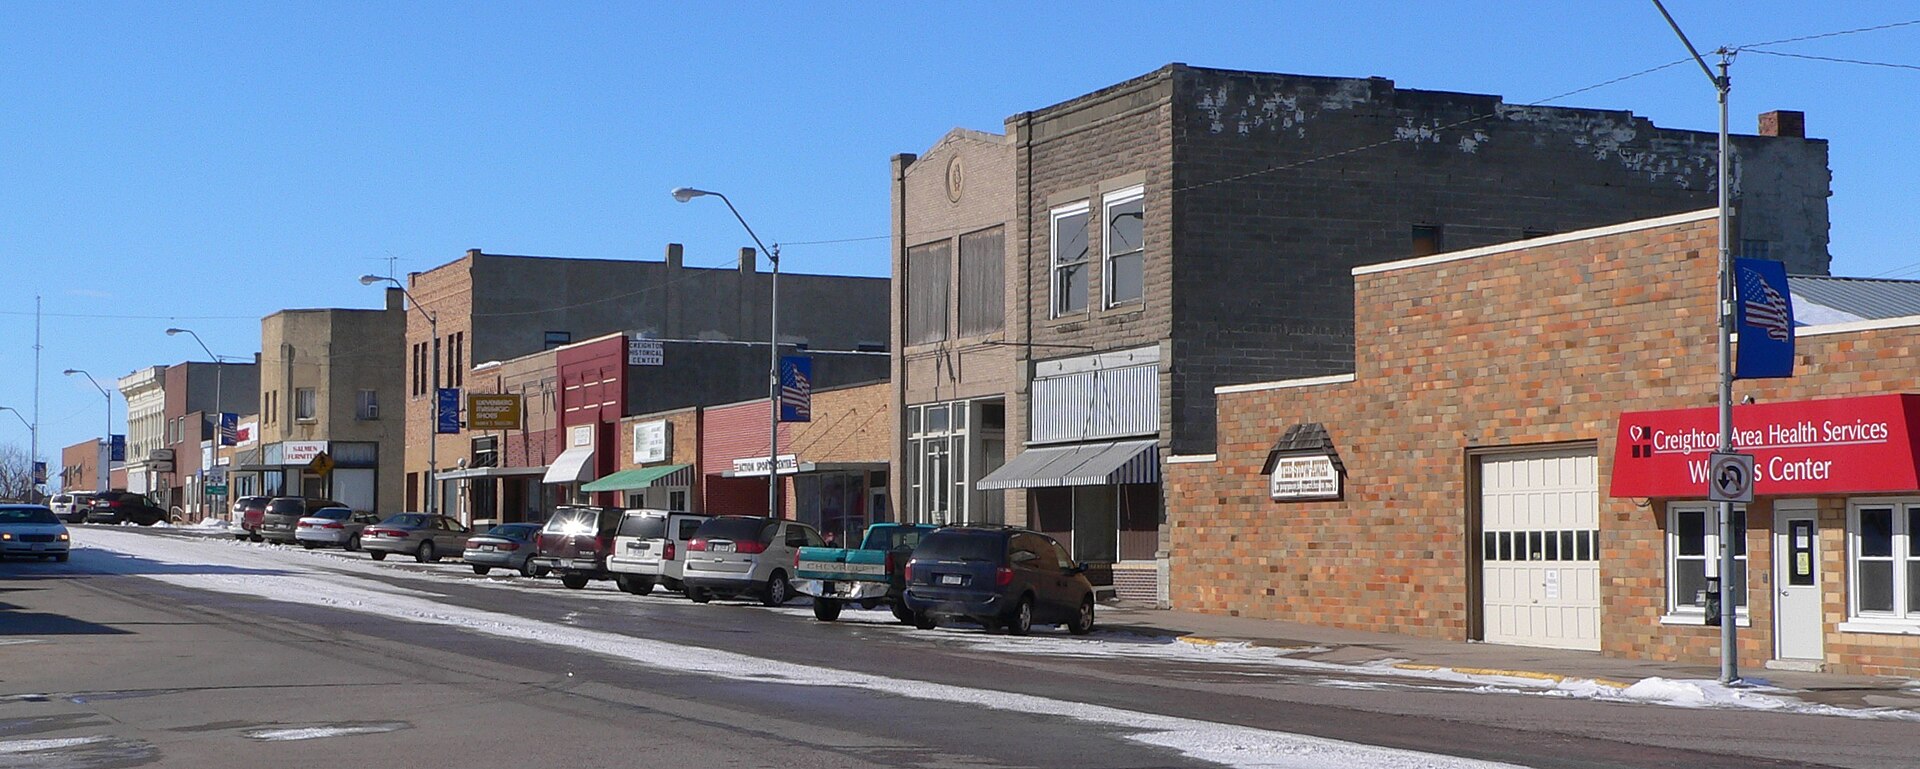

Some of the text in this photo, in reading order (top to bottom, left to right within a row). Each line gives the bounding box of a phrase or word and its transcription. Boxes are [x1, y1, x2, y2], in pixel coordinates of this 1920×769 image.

[1731, 427, 1763, 446] Area
[1768, 421, 1817, 444] Health
[1823, 418, 1888, 442] Services
[1769, 456, 1832, 481] Center
[807, 562, 879, 573] CHEVROLET
